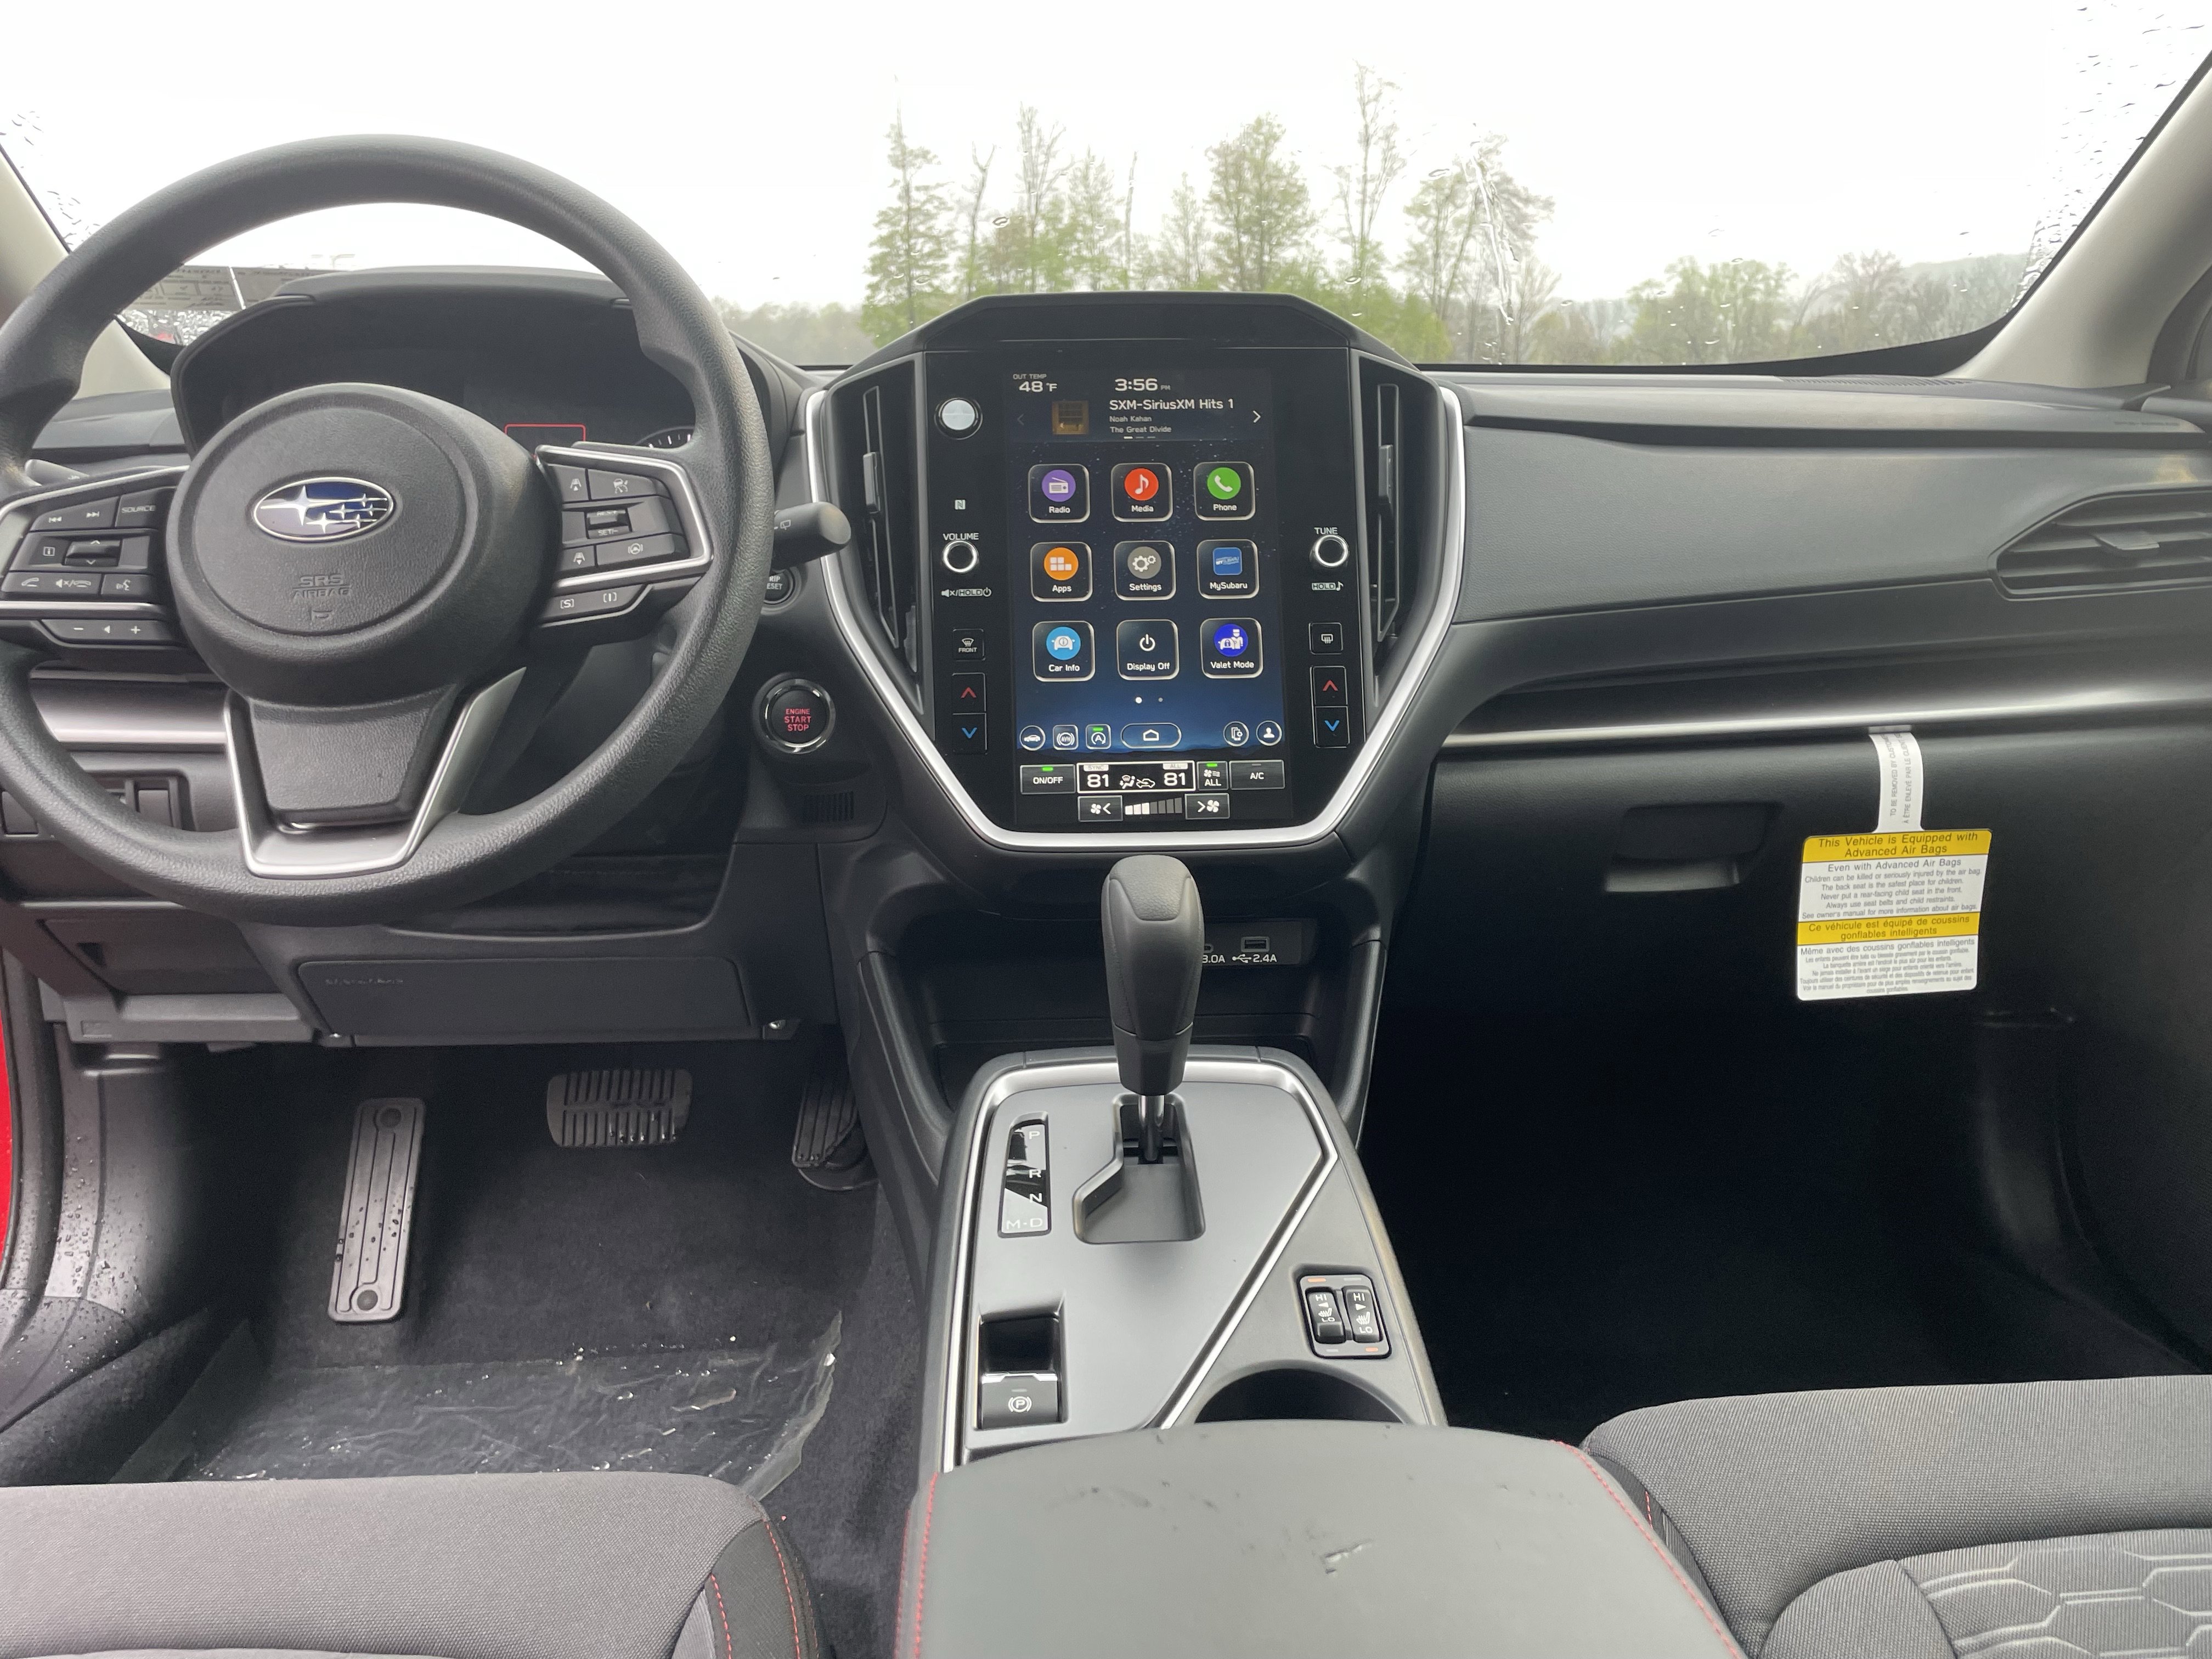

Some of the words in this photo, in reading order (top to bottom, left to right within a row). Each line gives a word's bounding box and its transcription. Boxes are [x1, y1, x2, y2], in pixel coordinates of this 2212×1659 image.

[1019, 381, 1043, 392] 48
[1115, 378, 1158, 391] 3:56
[1109, 399, 1195, 410] SXM-SiriusXM
[1199, 399, 1223, 409] Hits
[1228, 399, 1233, 409] 1
[300, 574, 343, 587] SRS
[1052, 585, 1071, 593] Apps
[1130, 583, 1161, 592] Settings
[1210, 582, 1248, 591] MySubaru
[292, 587, 351, 599] AIRBAG
[1127, 662, 1155, 672] Display
[1087, 774, 1109, 787] 81
[1164, 772, 1186, 786] 81
[1819, 838, 1839, 848] This
[1845, 836, 1883, 846] Vehicle
[1888, 835, 1896, 844] is
[1901, 834, 1951, 845] Equipped
[1956, 833, 1978, 841] with
[1845, 845, 1897, 857] Advanced
[1901, 845, 1916, 855] Air
[1921, 845, 1947, 855] Bags
[1828, 864, 1849, 872] Even
[1854, 861, 1871, 871] with
[1876, 860, 1918, 870] Advanced
[1939, 859, 1961, 867] Bags
[1805, 874, 1830, 883] Children
[1860, 890, 1892, 899] rear-facing
[1826, 901, 1847, 910] Always
[1809, 923, 1821, 932] Ce
[1825, 921, 1861, 930] véhicule
[1866, 919, 1878, 928] est
[1883, 918, 1912, 929] équipé
[1931, 915, 1969, 924] coussins
[1841, 929, 1886, 941] gonflables
[1890, 927, 1937, 939] intelligents
[1801, 946, 1822, 955] Même
[1863, 943, 1894, 951] coussins
[1897, 940, 1933, 950] gonflables
[1937, 938, 1974, 948] intelligents
[1253, 953, 1277, 963] 2.4A
[1029, 1131, 1040, 1139] P
[1029, 1169, 1041, 1178] R
[1029, 1193, 1042, 1203] N
[1353, 1293, 1365, 1301] HI
